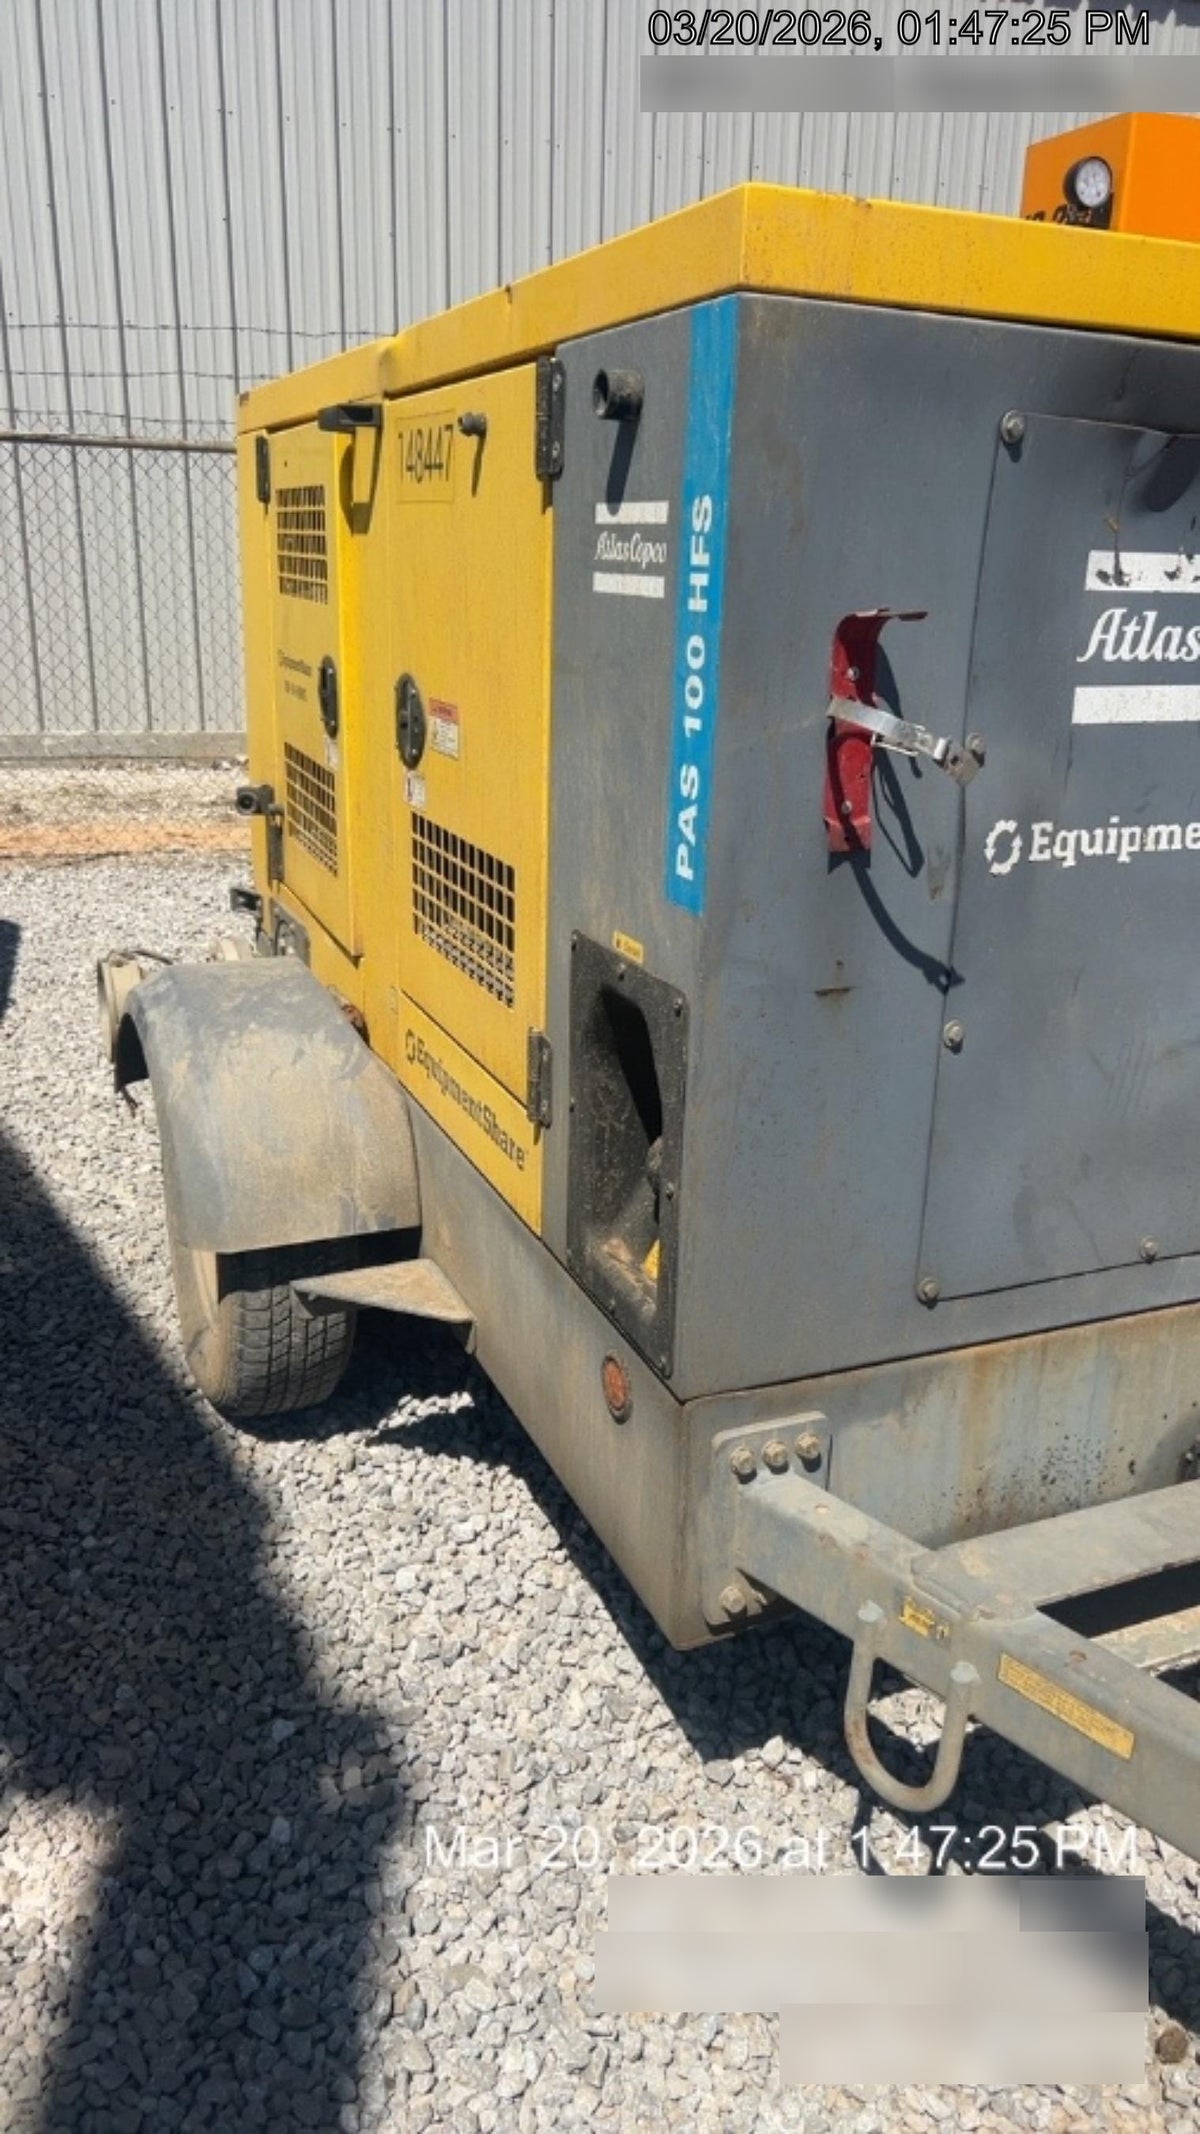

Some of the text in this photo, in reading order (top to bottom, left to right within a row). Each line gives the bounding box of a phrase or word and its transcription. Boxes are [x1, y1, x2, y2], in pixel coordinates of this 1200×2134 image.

[398, 424, 454, 484] 148447
[675, 494, 712, 881] PAS 100 HFS
